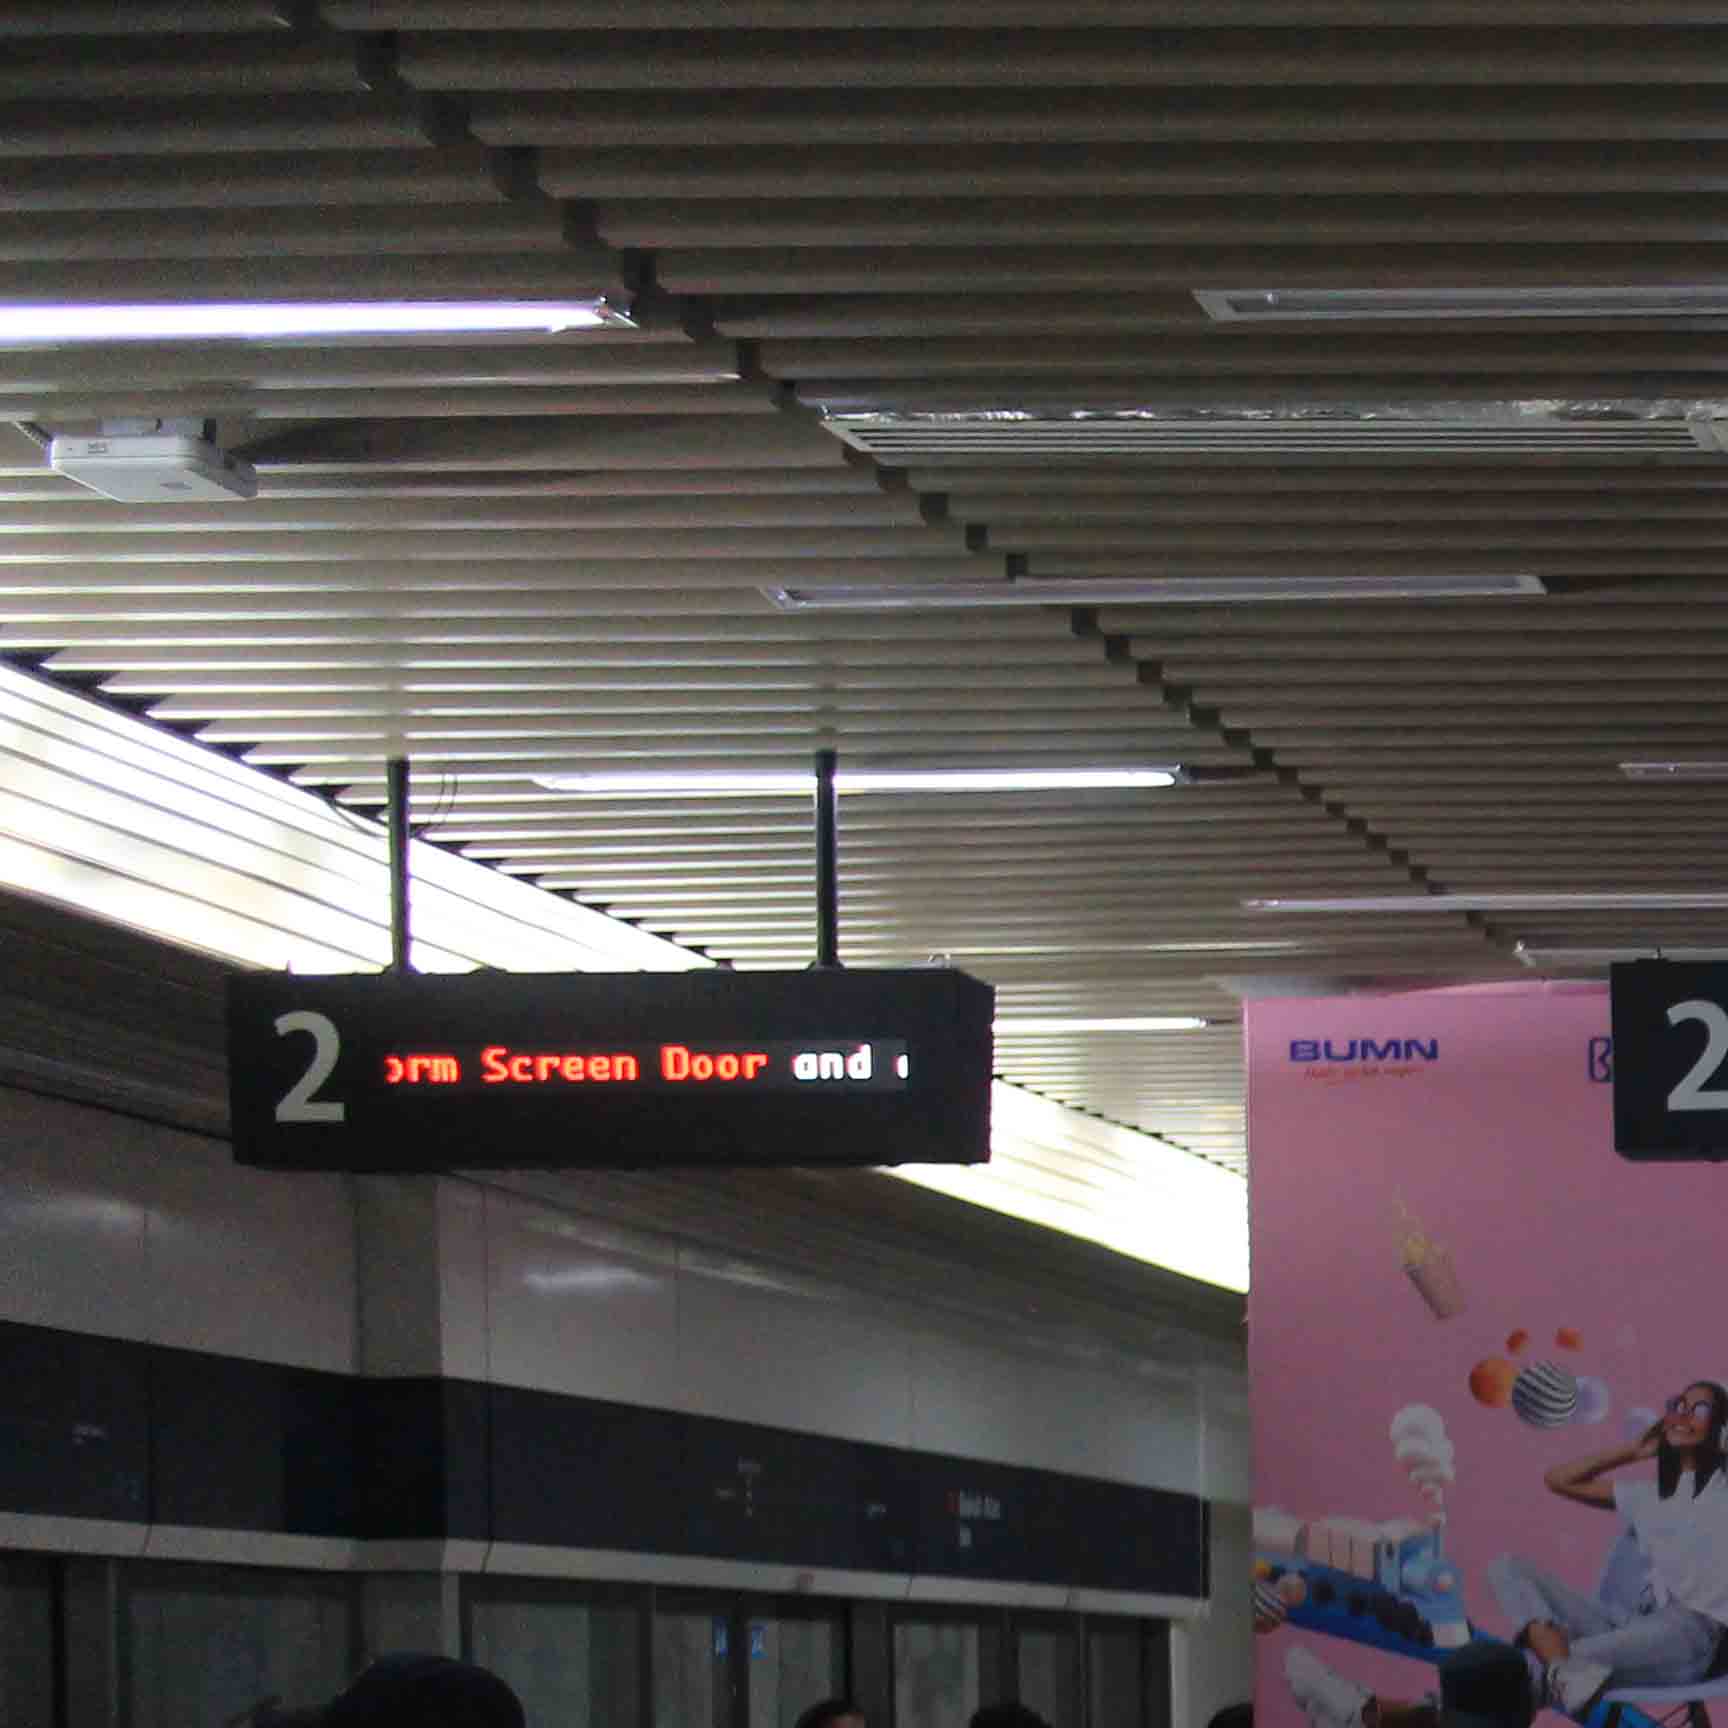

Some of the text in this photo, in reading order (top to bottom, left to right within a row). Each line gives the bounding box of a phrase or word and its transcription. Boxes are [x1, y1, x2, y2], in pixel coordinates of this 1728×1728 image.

[273, 1010, 345, 1123] 2
[482, 1046, 638, 1083] Screen
[660, 1045, 768, 1081] Door
[792, 1044, 872, 1080] and
[1289, 1039, 1439, 1062] BUMN
